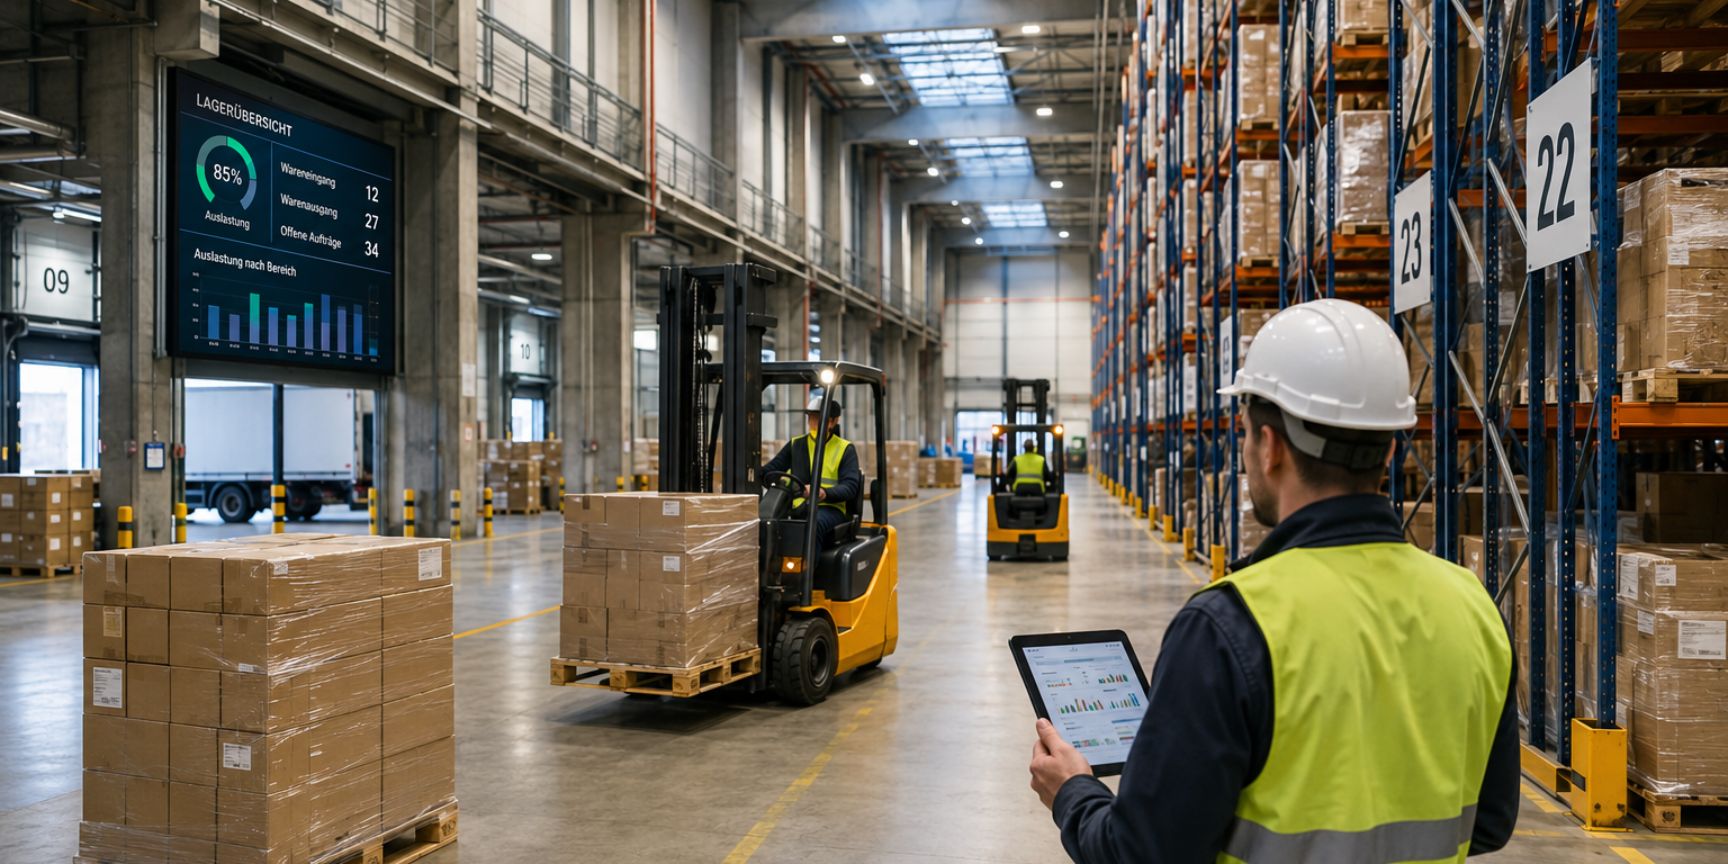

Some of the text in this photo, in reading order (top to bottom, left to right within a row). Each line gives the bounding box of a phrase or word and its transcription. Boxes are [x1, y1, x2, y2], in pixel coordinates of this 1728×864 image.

[196, 93, 293, 137] LAGERÜBERSICHT
[213, 163, 243, 186] 85%
[280, 161, 379, 203] Wareneingang 12
[1537, 121, 1575, 232] 22
[205, 210, 250, 231] Auslastung
[280, 193, 379, 230] Warenausgang 27
[280, 225, 379, 258] Offene Aufträge 34
[1400, 211, 1422, 285] 23
[194, 248, 297, 277] Auslastung nach Bereich
[43, 267, 70, 295] 09
[520, 343, 531, 360] 10
